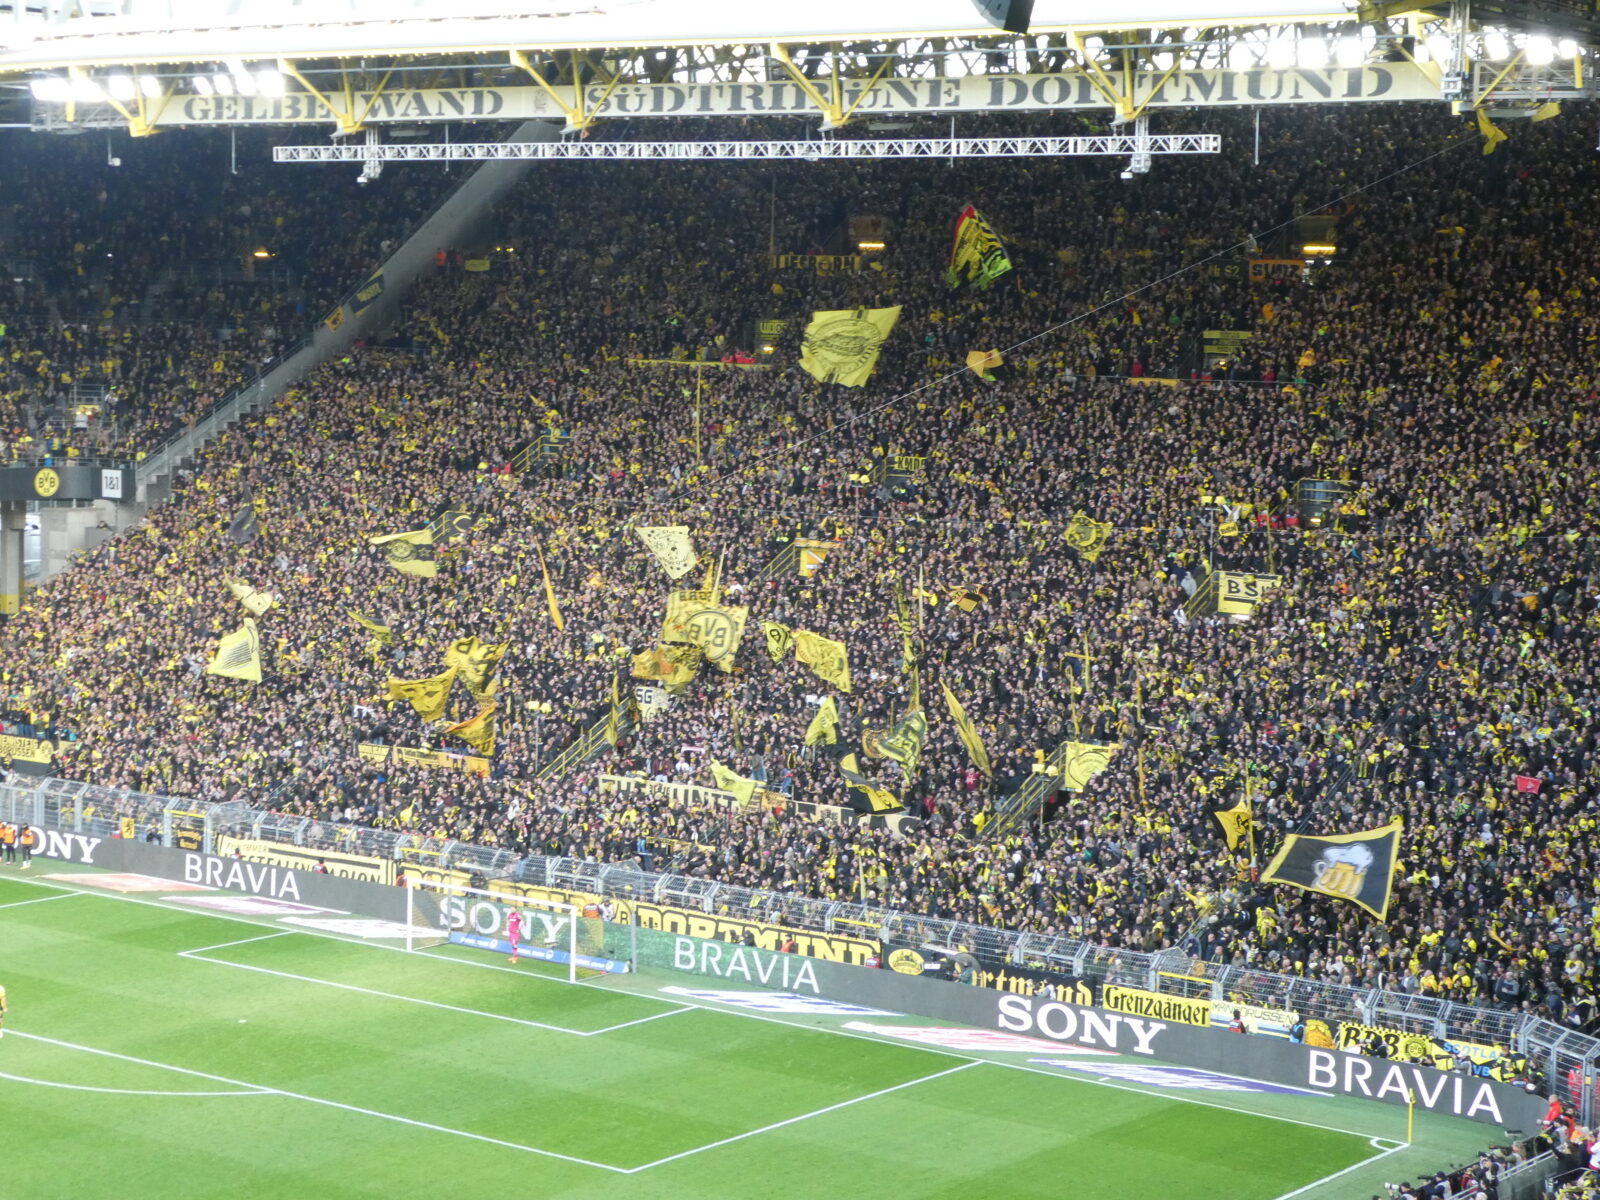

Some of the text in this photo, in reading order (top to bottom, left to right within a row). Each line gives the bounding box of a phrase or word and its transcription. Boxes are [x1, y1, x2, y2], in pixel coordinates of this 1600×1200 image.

[183, 92, 331, 121] GELBE
[361, 89, 503, 117] WAND
[586, 78, 961, 113] SÜDTRIBÜNE
[104, 476, 120, 490] 1&1
[184, 853, 300, 900] BRAVIA
[674, 937, 820, 994] BRAVIA
[998, 994, 1167, 1055] SONY
[1104, 985, 1210, 1026] Grenzgänger
[1308, 1049, 1503, 1124] BRAVIA
